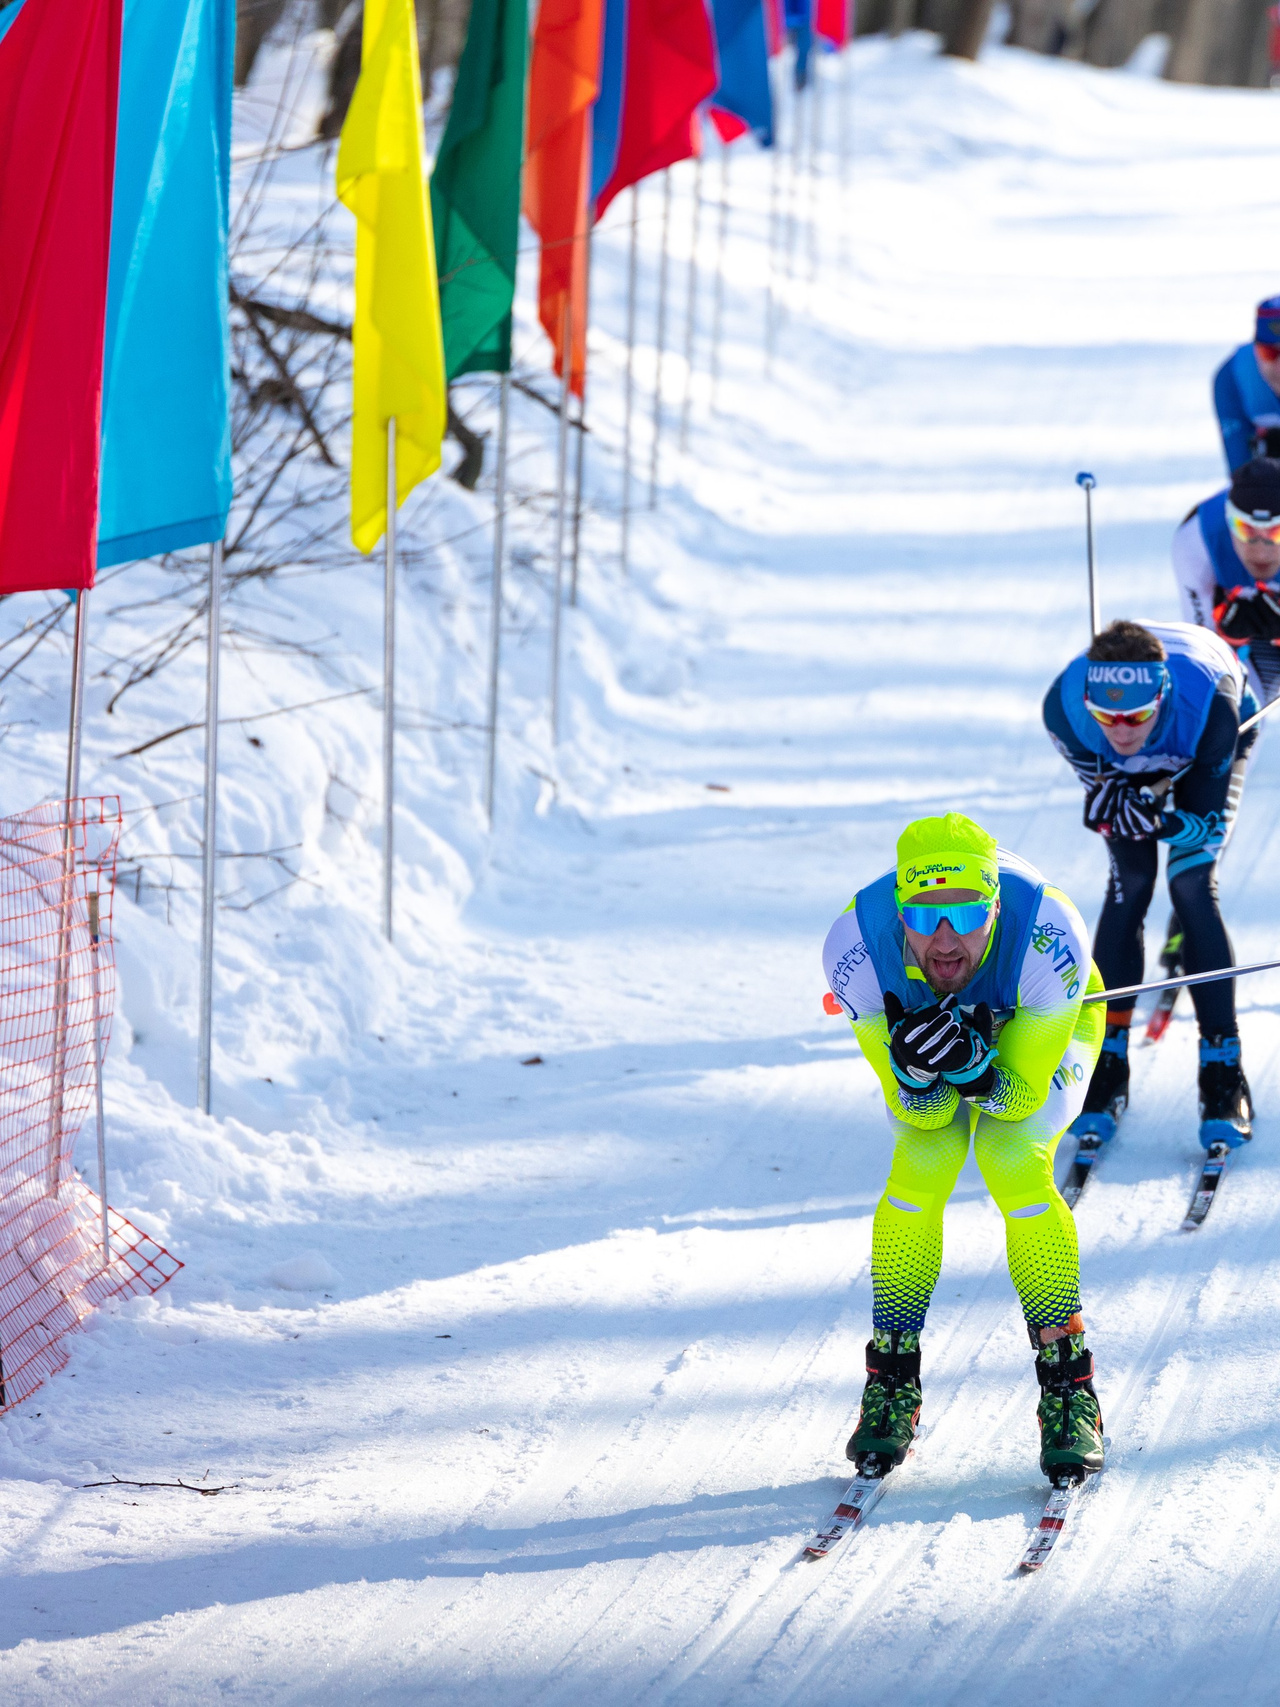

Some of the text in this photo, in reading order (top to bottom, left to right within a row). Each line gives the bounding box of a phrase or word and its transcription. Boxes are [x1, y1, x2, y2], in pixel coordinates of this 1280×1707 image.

[1087, 665, 1153, 685] LUKOIL
[916, 865, 962, 877] FUTURA
[1031, 922, 1080, 1000] RENTINO
[1050, 1062, 1084, 1091] TINO
